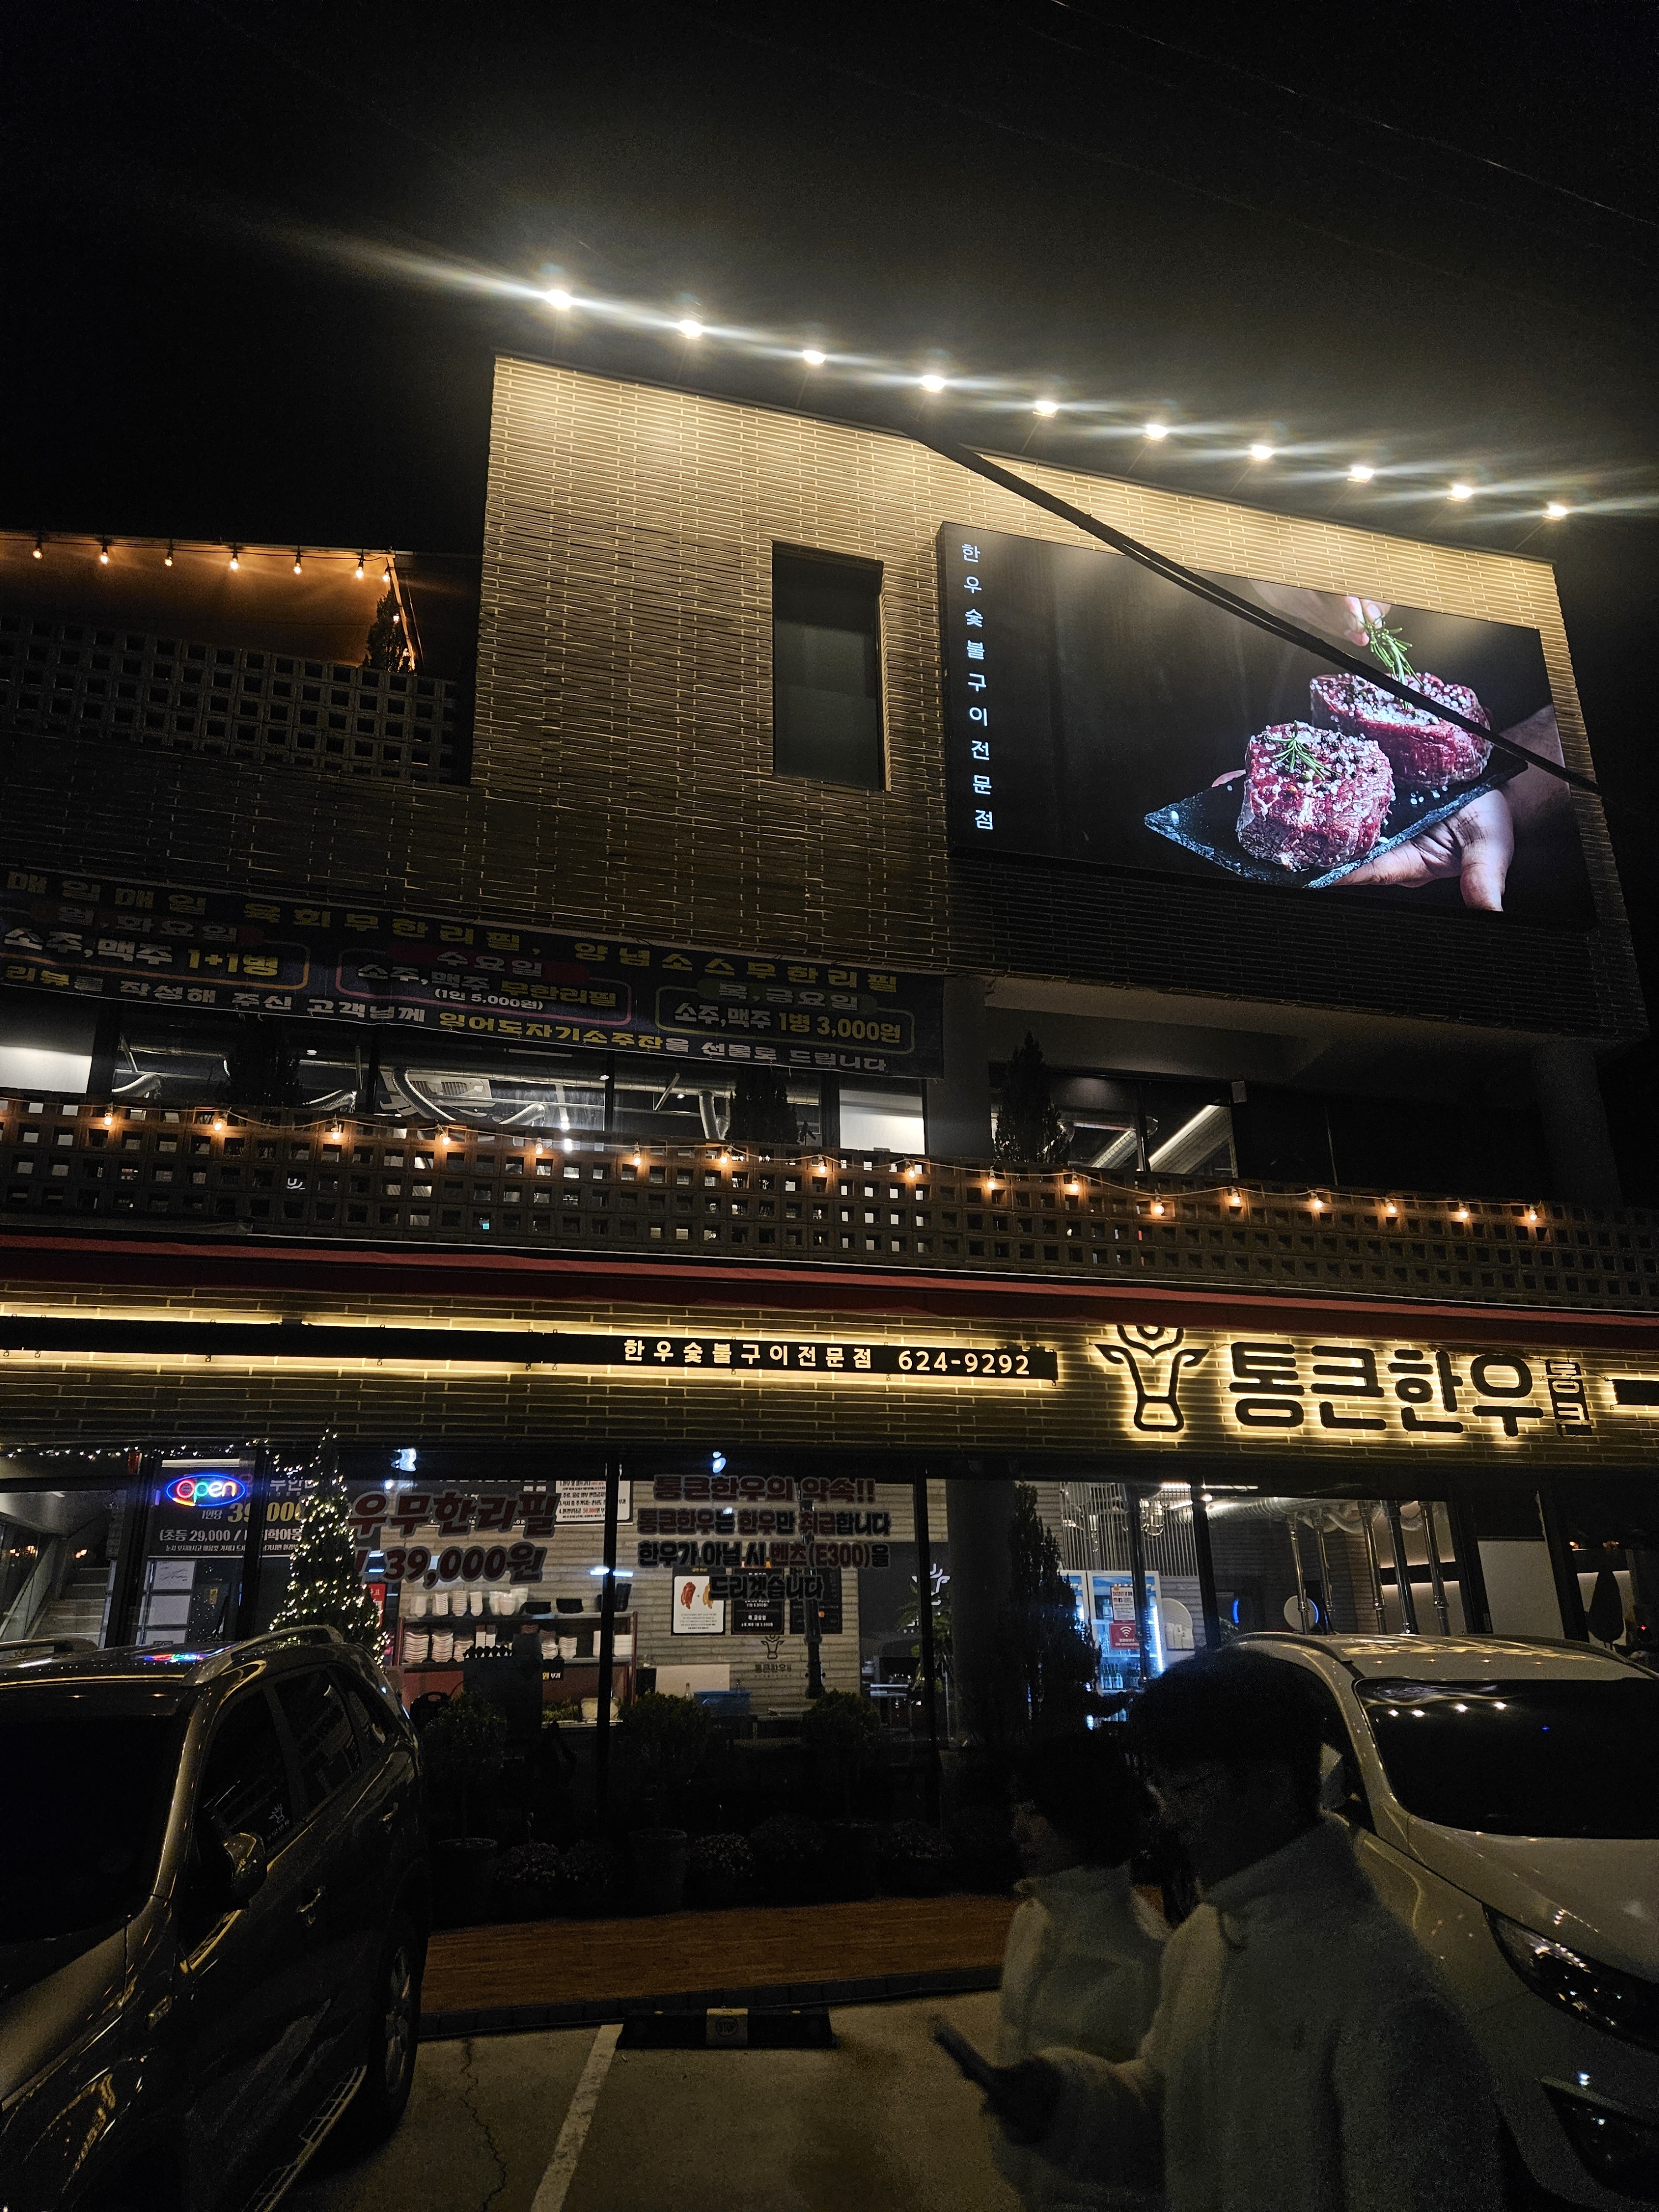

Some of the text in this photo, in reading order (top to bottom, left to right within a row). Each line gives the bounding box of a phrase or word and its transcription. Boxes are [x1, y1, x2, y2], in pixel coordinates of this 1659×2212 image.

[4, 928, 278, 975] 소주,맥주 1+1병
[437, 951, 542, 977] 수요일
[358, 964, 617, 1006] 소주,맥주 무한리필
[435, 988, 544, 1010] (1인 5,000원)
[6, 966, 103, 992] 리뷰를
[119, 980, 216, 1004] 작성해
[232, 993, 292, 1010] 주신
[307, 999, 425, 1022] 고객님께
[701, 1041, 777, 1061] 선물로
[789, 1050, 886, 1071] 드립니다
[674, 1003, 901, 1044] 소주,맥주 1병 3,000원
[624, 1339, 1030, 1376] 한우숯불구이전문점 624-9292
[1230, 1341, 1543, 1437] 통큰한우
[654, 1475, 876, 1503] 통큰한우의 약속!!
[202, 1510, 223, 1520] 1인당
[638, 1509, 891, 1536] 통큰한우는 한우만 취급합니다
[189, 1530, 231, 1542] 29,000
[384, 1542, 546, 1588] 39,000원
[638, 1542, 697, 1568] 한우가
[710, 1574, 823, 1601] 드리겠습니다
